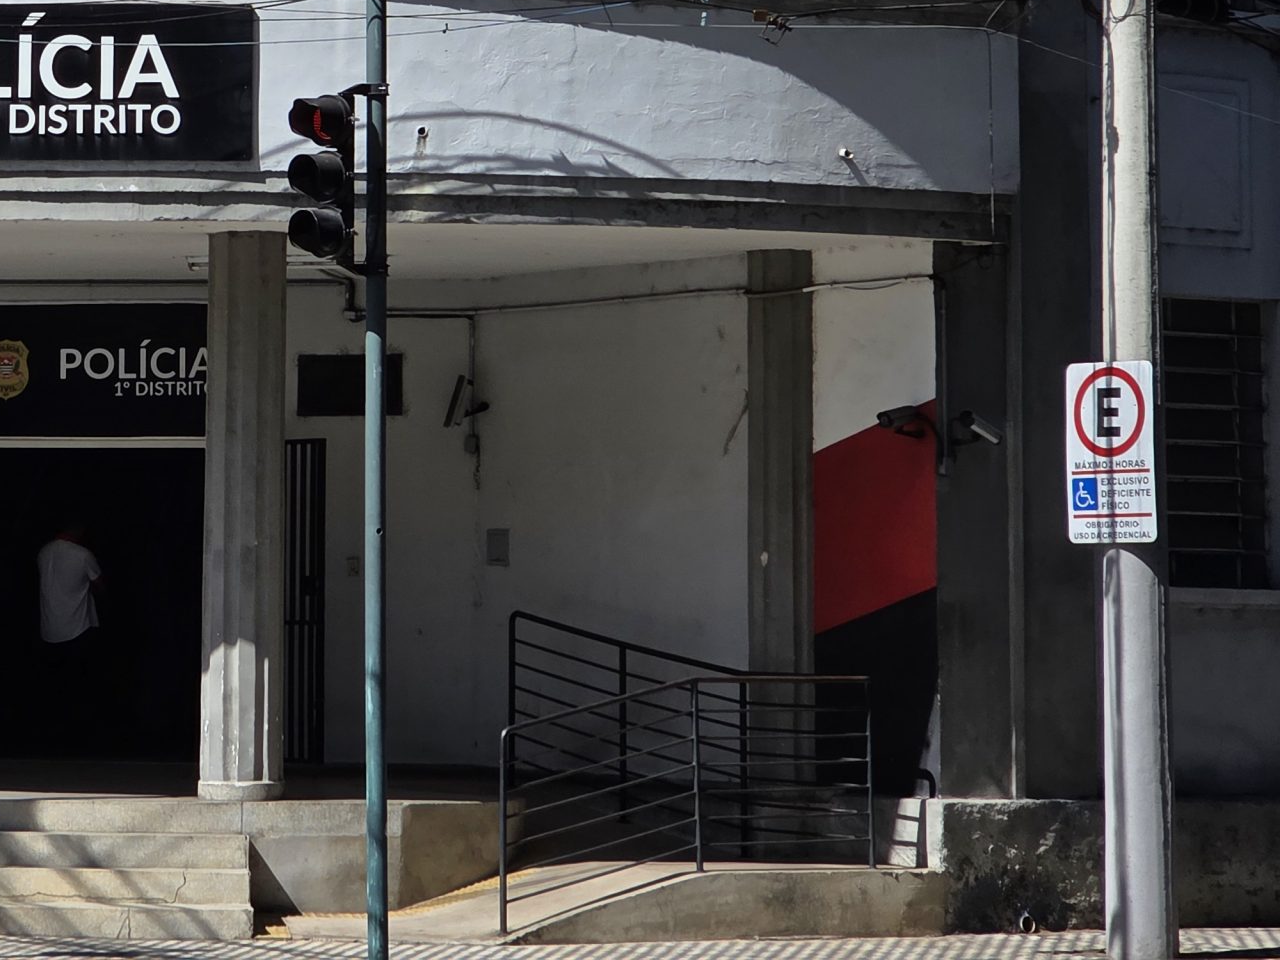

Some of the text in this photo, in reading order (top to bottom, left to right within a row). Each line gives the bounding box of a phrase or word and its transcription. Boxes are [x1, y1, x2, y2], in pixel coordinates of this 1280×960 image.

[9, 104, 181, 135] DISTRITO
[60, 340, 208, 379] POLÍCIA
[1097, 388, 1121, 437] E
[1074, 461, 1108, 470] MÁXIMO
[1115, 460, 1146, 468] HORAS
[1100, 476, 1149, 486] EXCLUSIVO
[1101, 488, 1152, 498] DEFICIENTE
[1102, 500, 1130, 510] FÍSICO
[1074, 531, 1152, 540] USO DA CREDENCIAL
